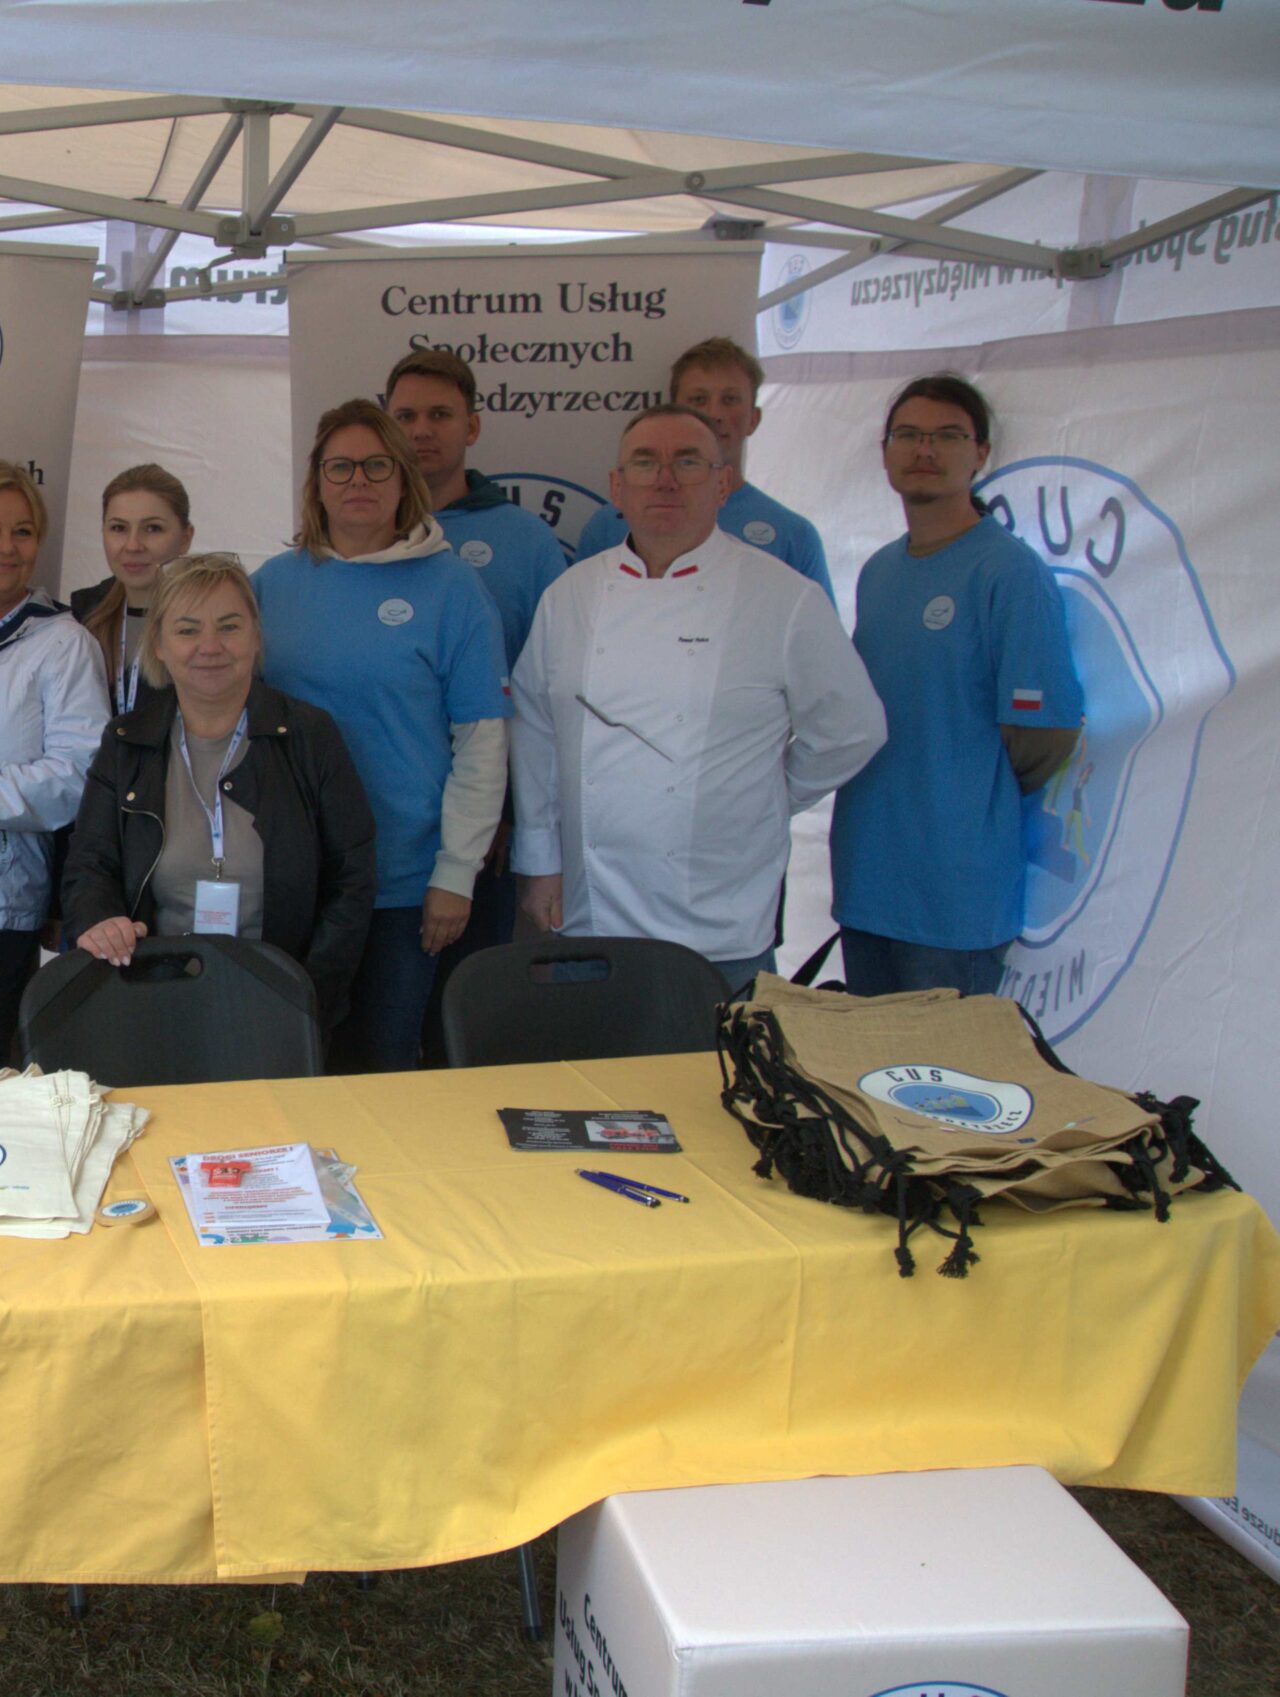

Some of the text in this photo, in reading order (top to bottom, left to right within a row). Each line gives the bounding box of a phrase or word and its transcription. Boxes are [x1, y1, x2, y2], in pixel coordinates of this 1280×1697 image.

[381, 282, 666, 319] Centrum Usług
[885, 1068, 943, 1083] CUS
